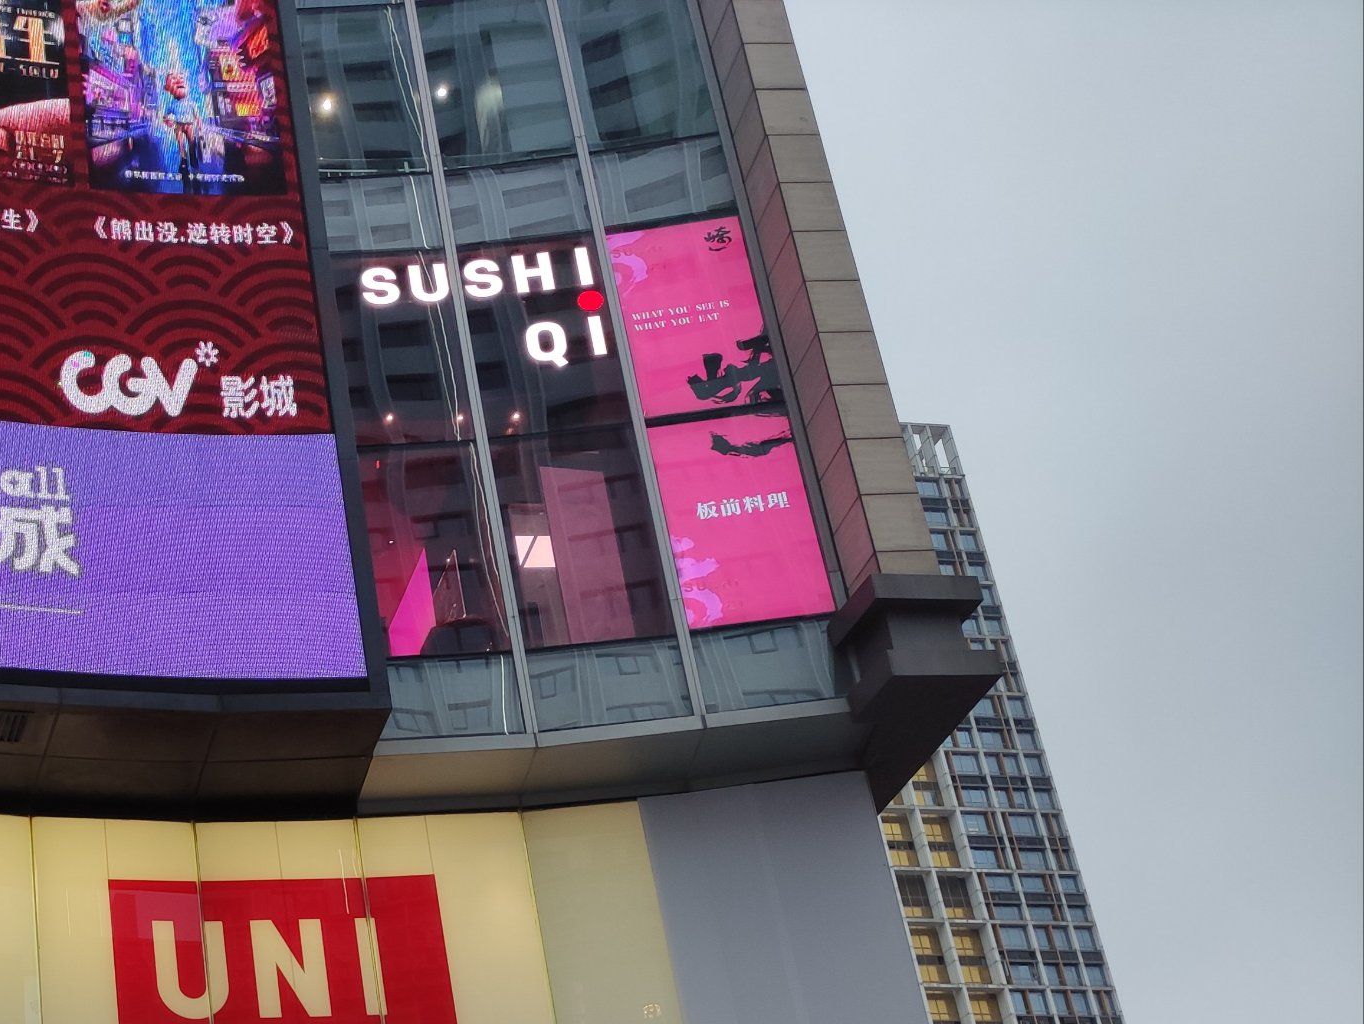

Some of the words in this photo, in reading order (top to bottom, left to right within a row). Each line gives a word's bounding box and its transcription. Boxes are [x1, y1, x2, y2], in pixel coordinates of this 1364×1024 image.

[360, 246, 596, 305] SUSHI
[631, 307, 664, 322] WHAT
[668, 304, 691, 317] YOU
[695, 301, 716, 313] SEE
[718, 299, 730, 310] IS
[633, 319, 666, 332] WHAT
[670, 315, 694, 327] YOU
[698, 312, 720, 324] EAT
[524, 314, 609, 368] QI
[59, 348, 199, 419] CGV
[219, 374, 299, 420] 影城
[696, 491, 791, 520] 板前料理
[150, 916, 387, 1020] UNI
